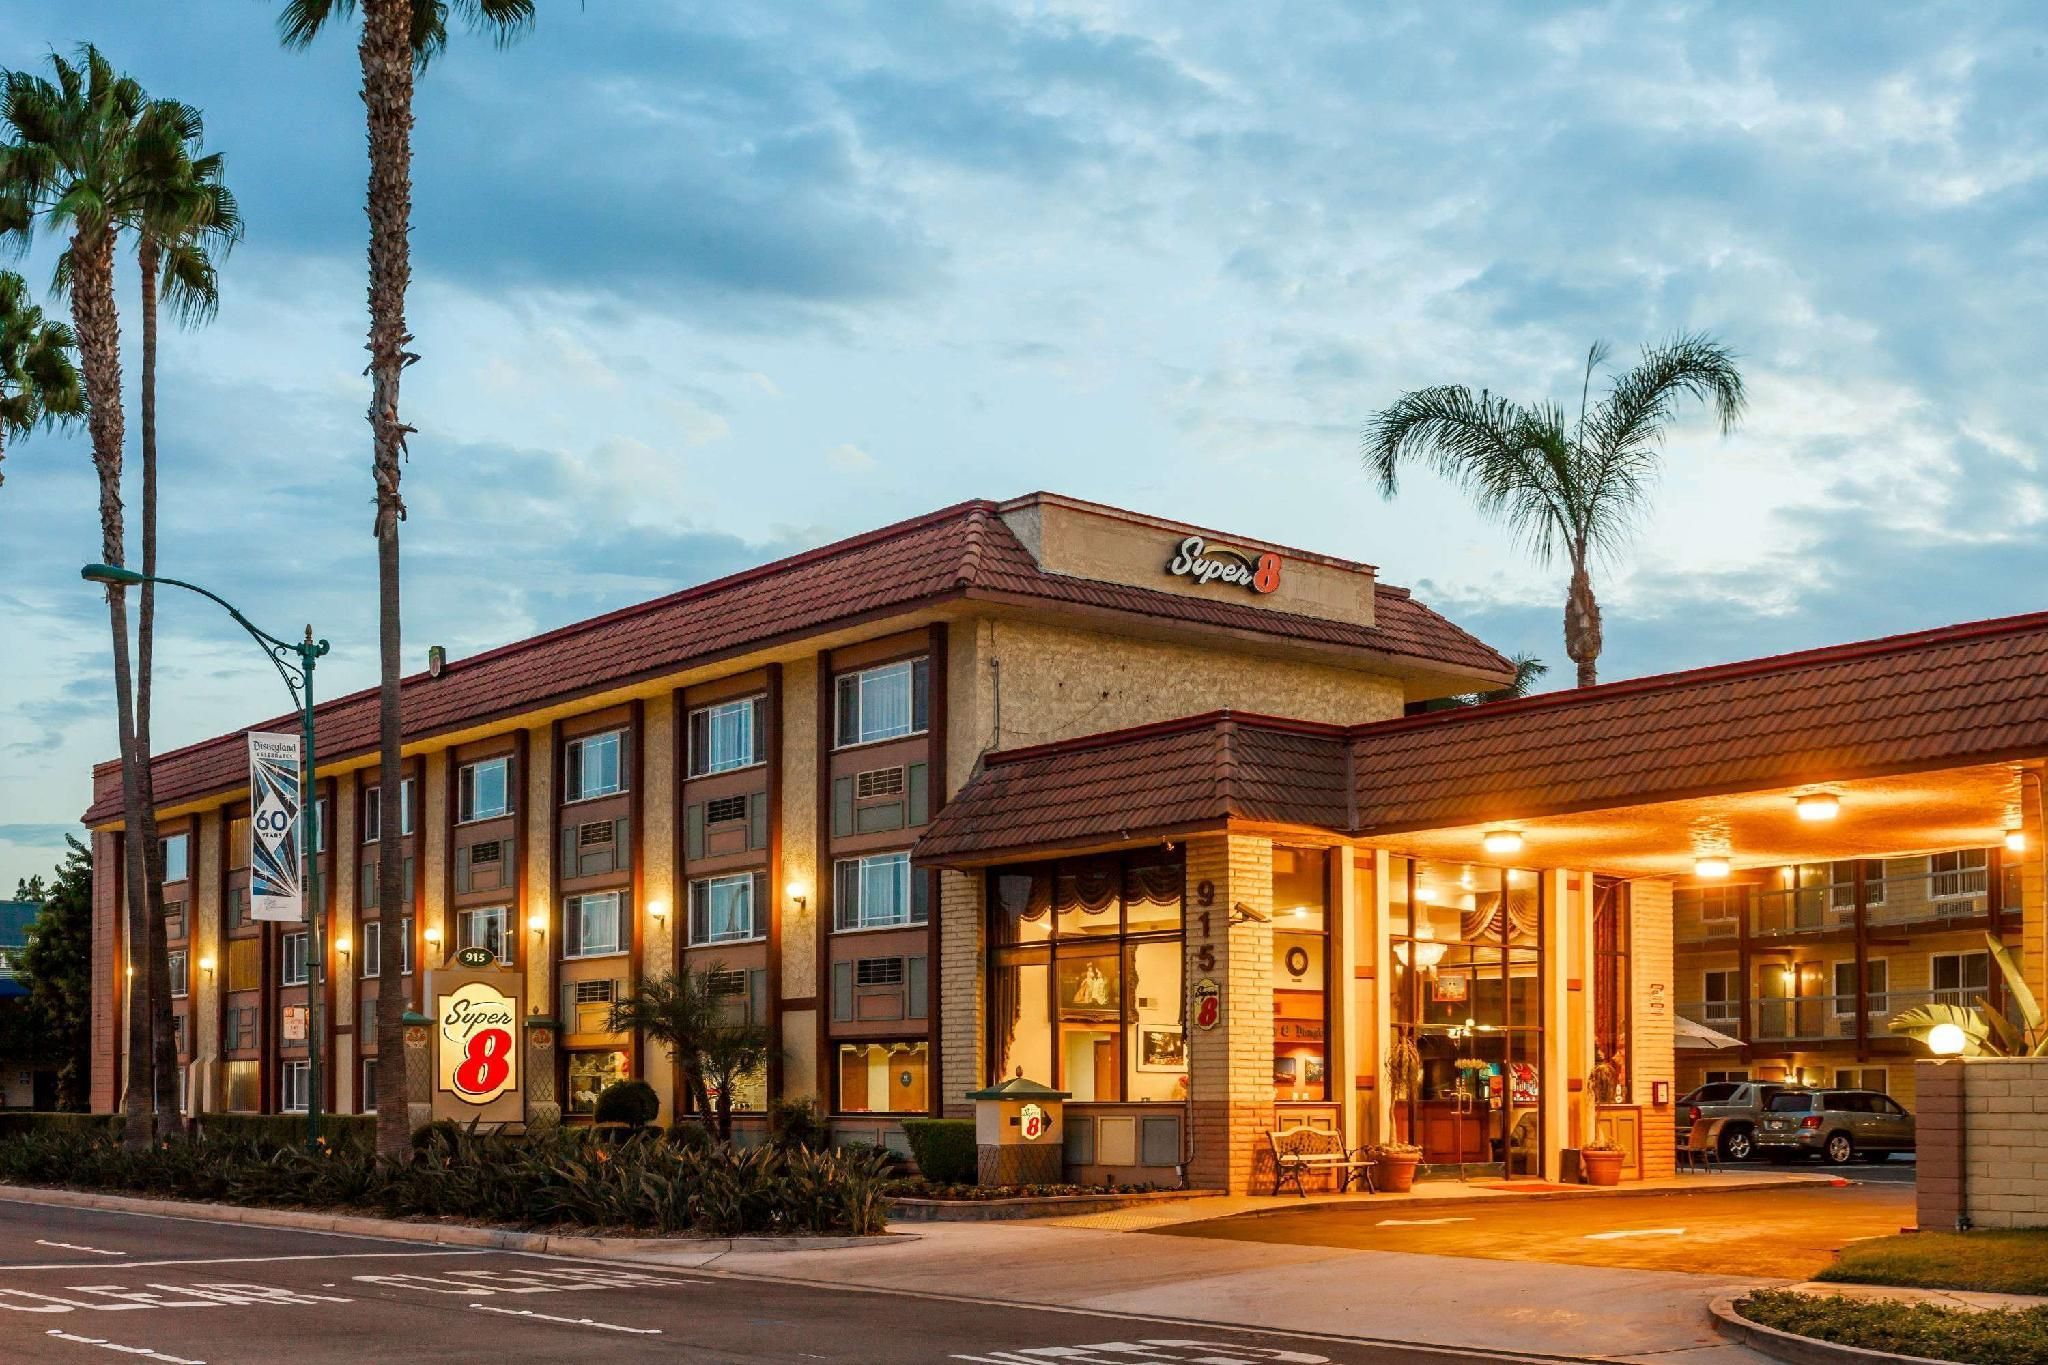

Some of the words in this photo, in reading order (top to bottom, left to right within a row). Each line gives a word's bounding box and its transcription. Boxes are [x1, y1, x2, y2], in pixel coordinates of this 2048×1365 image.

[1171, 536, 1253, 585] Super
[1253, 553, 1283, 594] 8
[252, 740, 297, 753] Disneyland
[256, 810, 288, 831] 60
[465, 952, 486, 963] 915
[1195, 985, 1218, 1003] Super
[444, 998, 513, 1038] Super
[1198, 996, 1218, 1026] 8
[453, 1028, 513, 1095] 8
[1026, 1117, 1040, 1136] 8
[351, 1267, 716, 1296] CLEAR
